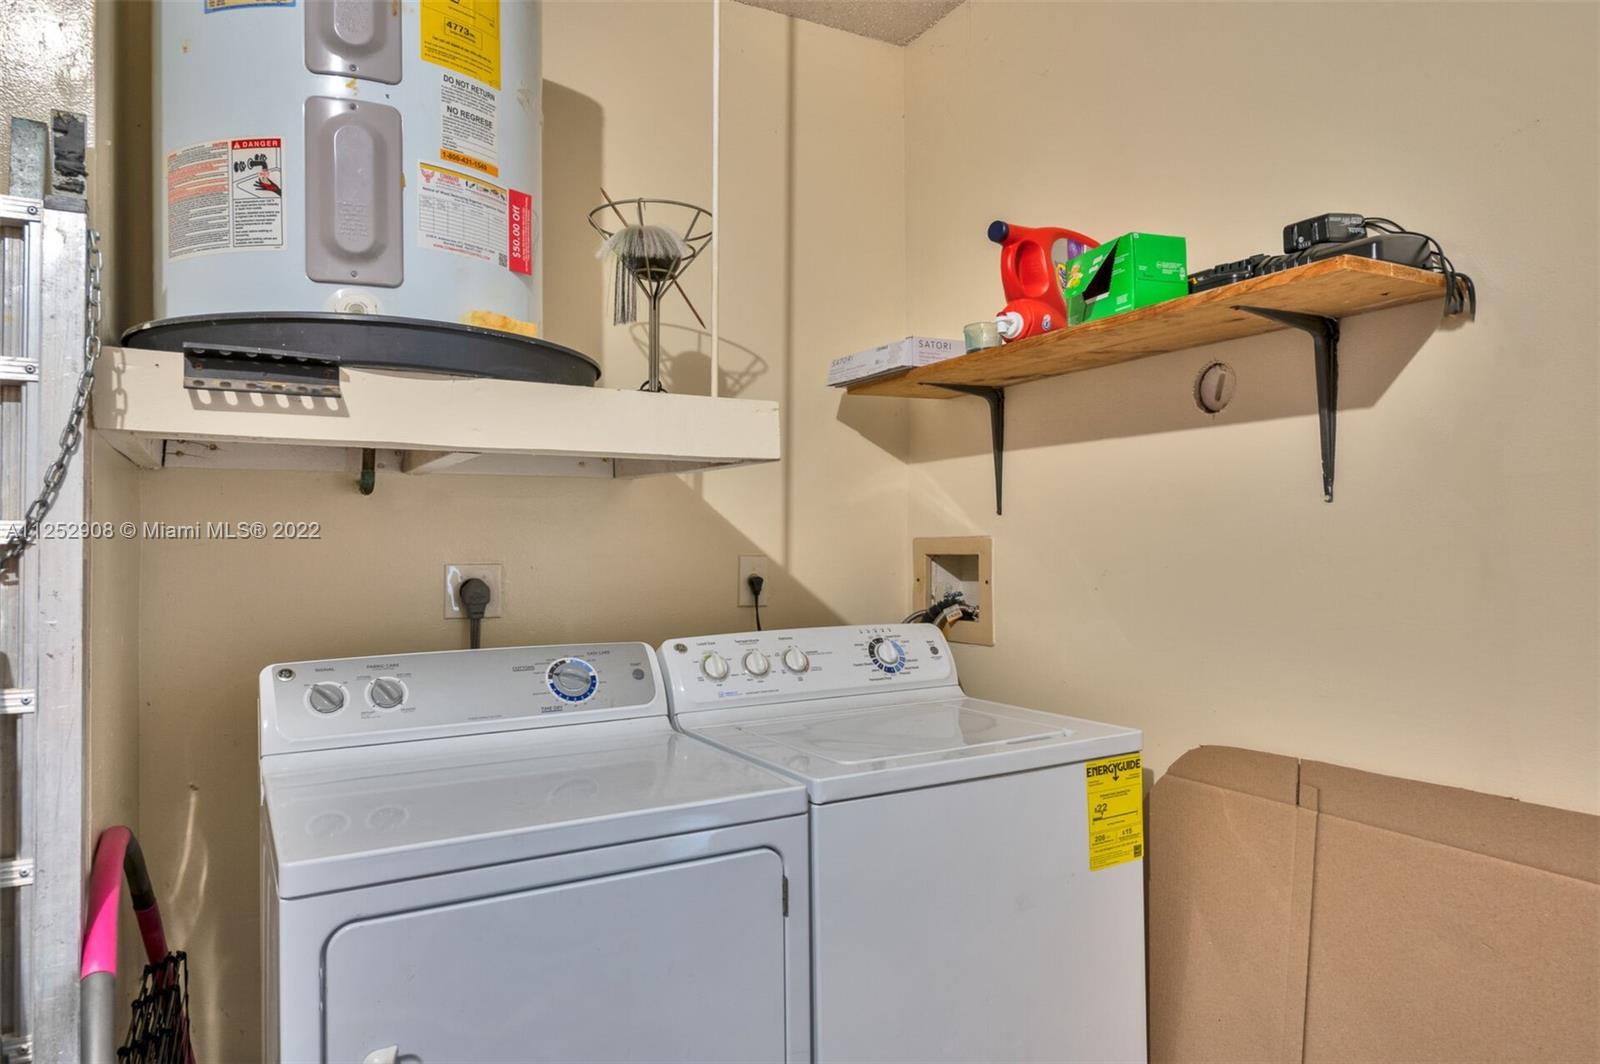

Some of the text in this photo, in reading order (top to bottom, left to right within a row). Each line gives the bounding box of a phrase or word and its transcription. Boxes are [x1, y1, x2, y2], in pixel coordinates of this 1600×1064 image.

[446, 21, 470, 36] 4773
[443, 74, 454, 84] DO
[455, 78, 469, 89] NOT
[470, 84, 495, 101] RETURN
[446, 105, 492, 128] NO REGRESE
[512, 204, 521, 258] $50.00 Off
[918, 339, 952, 351] SATORI
[1086, 758, 1141, 778] ENERGYGUIDE
